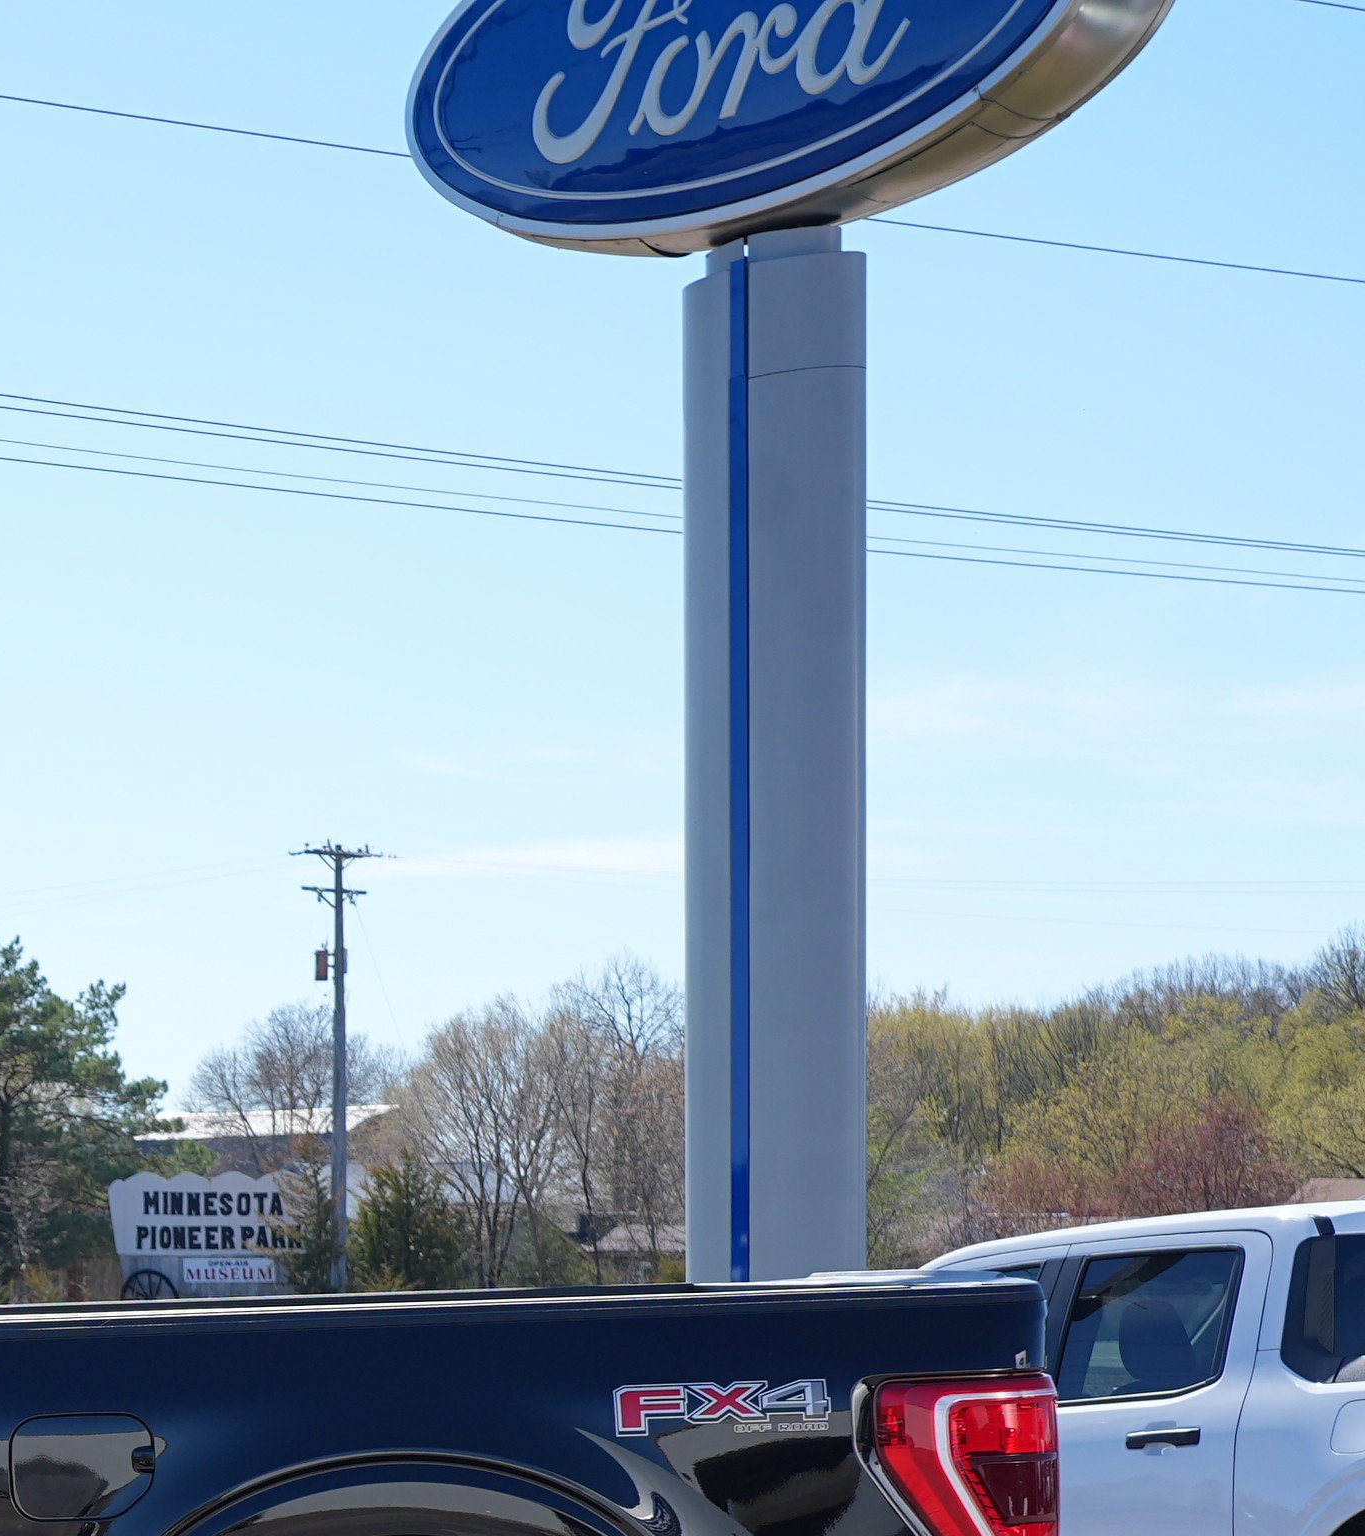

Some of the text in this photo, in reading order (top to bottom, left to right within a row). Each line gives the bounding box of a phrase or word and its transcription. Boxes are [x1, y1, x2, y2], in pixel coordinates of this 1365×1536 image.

[532, 0, 910, 164] Ford
[142, 1191, 284, 1216] MINNESOTA
[136, 1225, 236, 1250] PIONEER
[186, 1267, 273, 1280] MUSEUM
[612, 1378, 832, 1438] FX4
[733, 1421, 829, 1434] OFF ROAD
